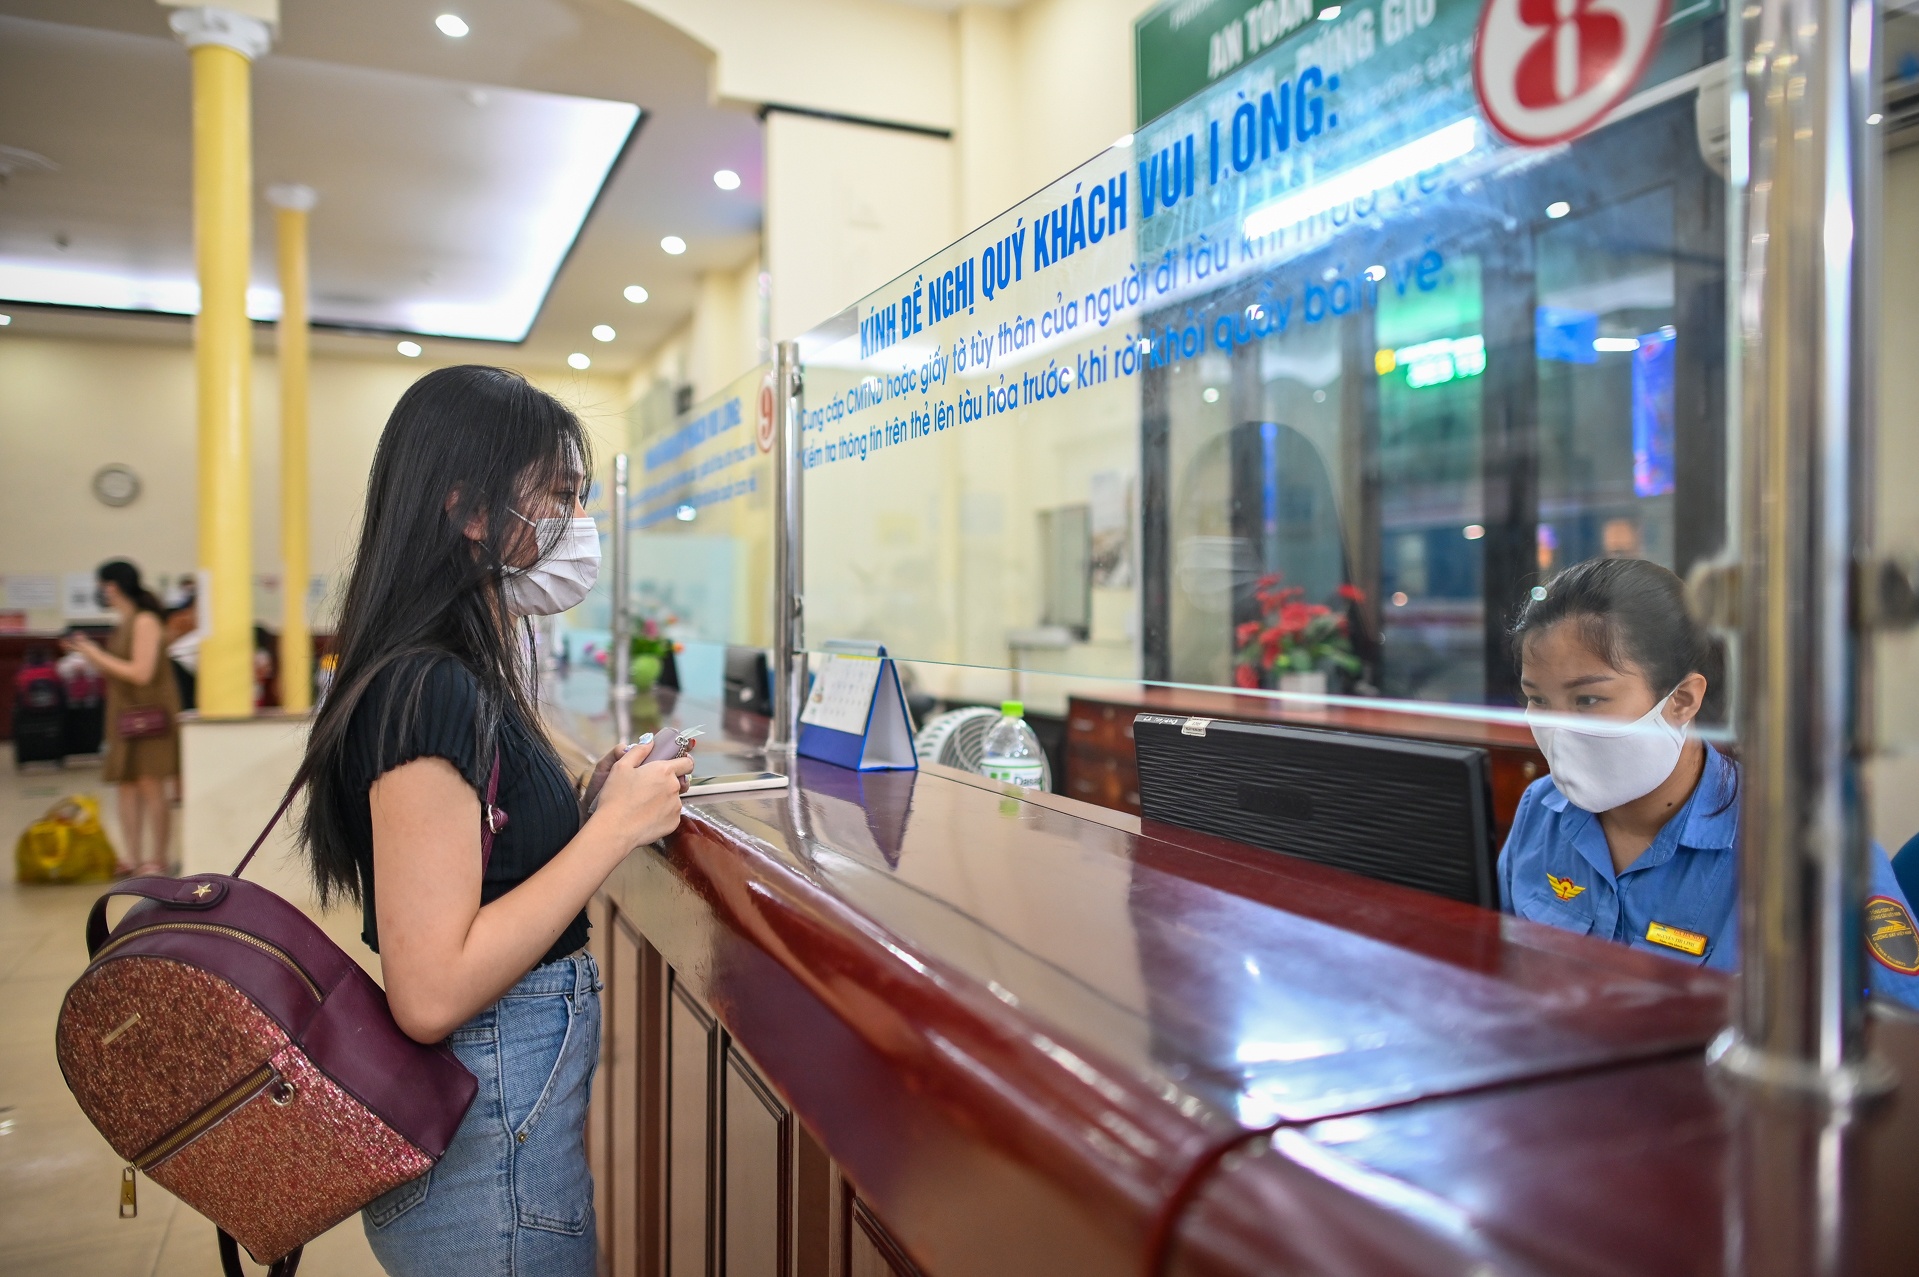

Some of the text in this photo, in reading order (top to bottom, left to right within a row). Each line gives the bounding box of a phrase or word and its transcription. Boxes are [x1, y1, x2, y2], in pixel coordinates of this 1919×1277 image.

[1208, 19, 1243, 80] AN
[801, 408, 823, 432] Cung
[826, 392, 844, 424] cấp
[847, 378, 883, 414] CMTND
[887, 363, 916, 400] hoặc
[920, 345, 949, 394] giấy
[953, 338, 967, 373] tờ
[971, 329, 994, 370] tùy
[998, 316, 1036, 356] thân
[1042, 292, 1078, 340] của
[1085, 262, 1147, 327] người
[1155, 247, 1177, 294] đi
[1186, 234, 1229, 284] tàu
[860, 306, 896, 360] KÍNH
[901, 275, 923, 339] ĐỀ
[929, 257, 975, 327] NGHỊ
[982, 217, 1026, 302] QUÝ
[1034, 170, 1127, 273] KHÁCH
[1139, 134, 1194, 219] VUI
[762, 386, 774, 439] 9
[825, 441, 836, 462] tra
[839, 433, 867, 461] thông
[870, 425, 882, 451] tin
[886, 417, 907, 446] trên
[911, 401, 930, 439] thẻ
[934, 401, 954, 432] lên
[959, 389, 982, 424] tàu
[987, 374, 1018, 416] hỏa
[1023, 358, 1070, 405] trước
[1077, 344, 1107, 389] khi
[1114, 335, 1145, 379] rời
[1150, 307, 1205, 369] khỏi
[1214, 280, 1291, 355] quầy
[1305, 262, 1377, 324] bán
